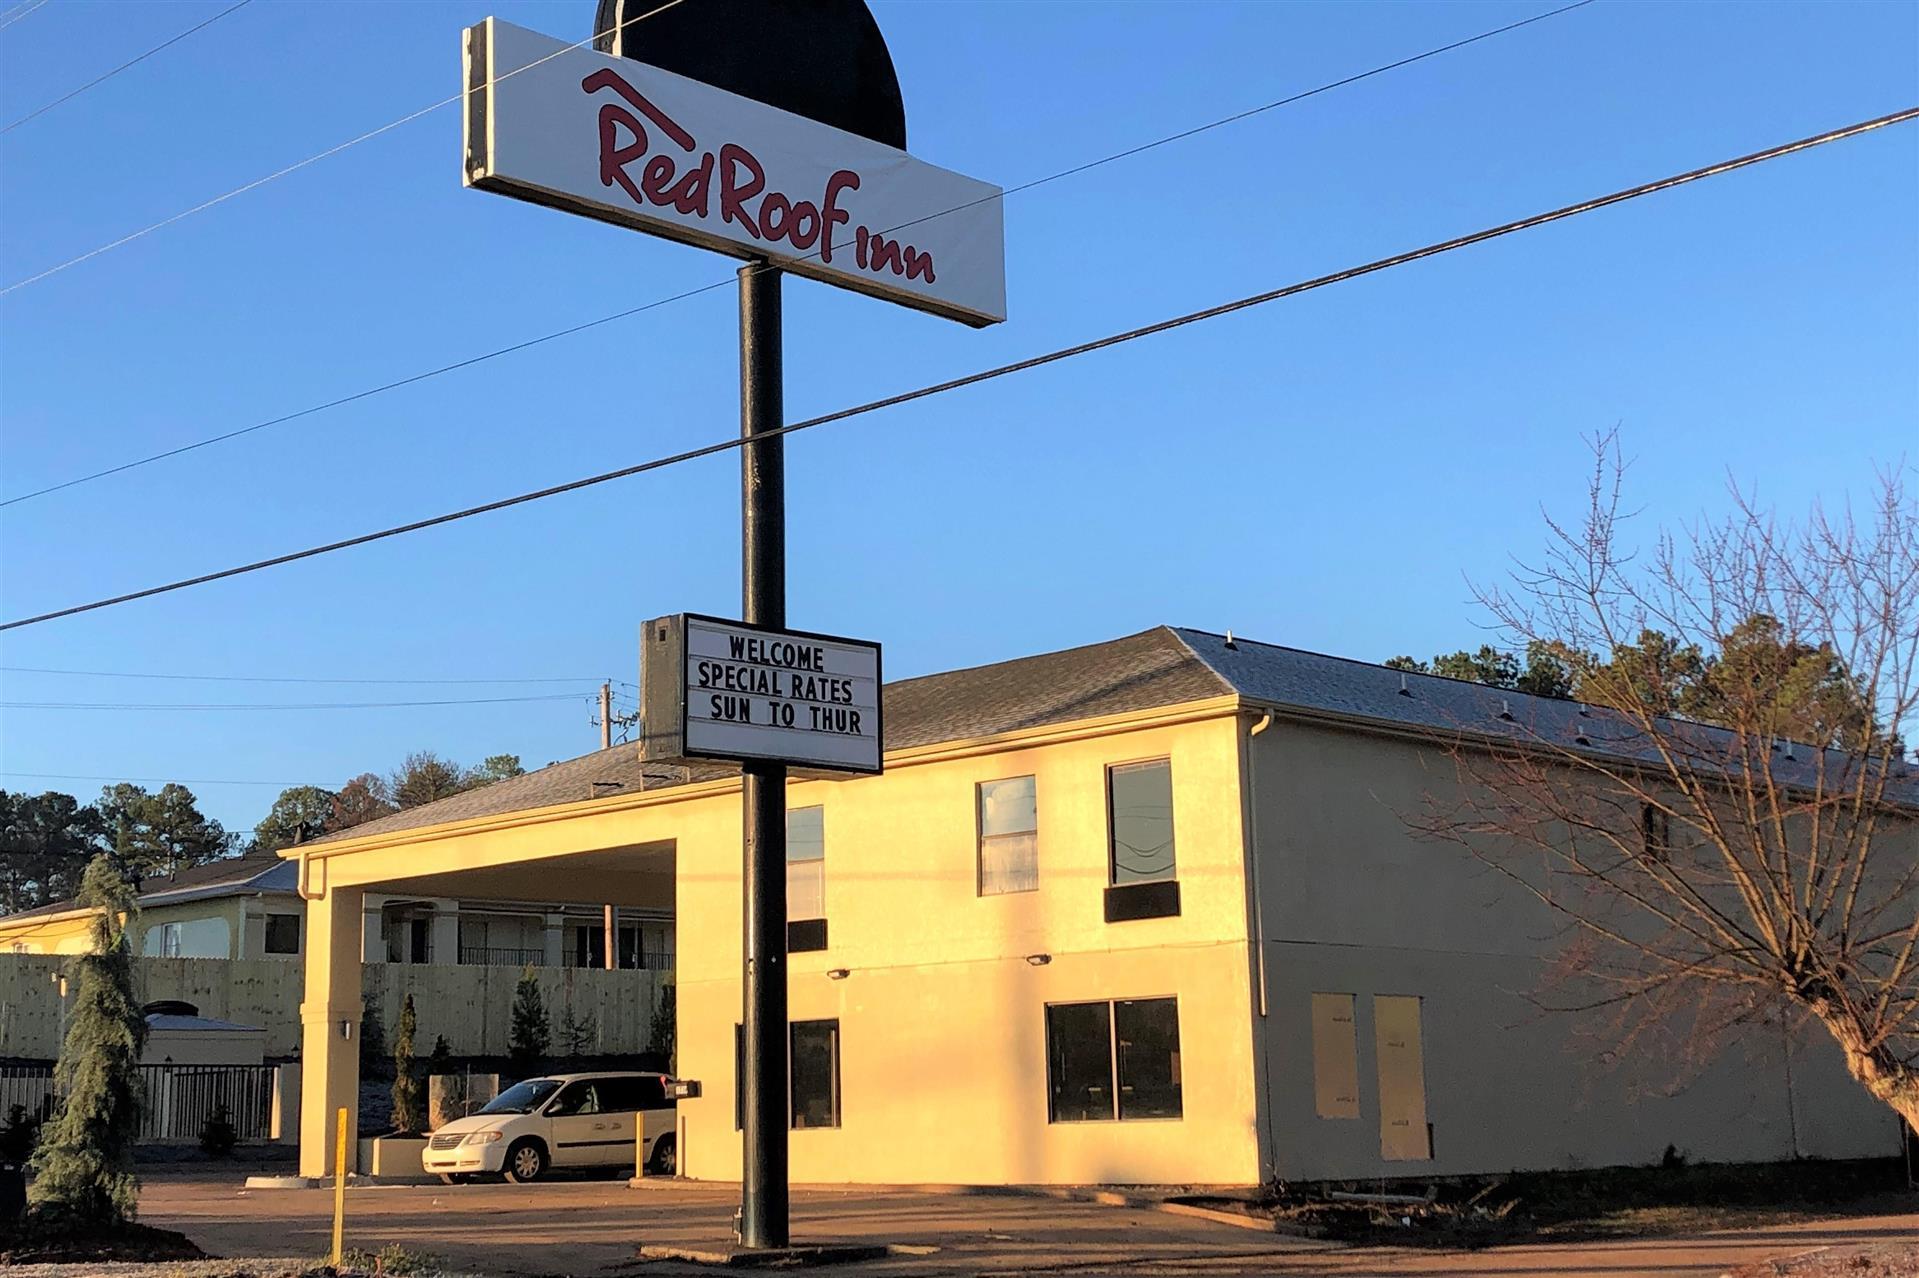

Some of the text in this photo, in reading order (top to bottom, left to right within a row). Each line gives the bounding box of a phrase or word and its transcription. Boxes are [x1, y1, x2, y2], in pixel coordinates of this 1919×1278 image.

[599, 104, 714, 218] Red
[719, 143, 860, 263] Roof
[729, 635, 824, 672] WELCOME
[698, 661, 853, 705] SPECIAL RATES
[711, 694, 862, 735] SUN TO THUR
